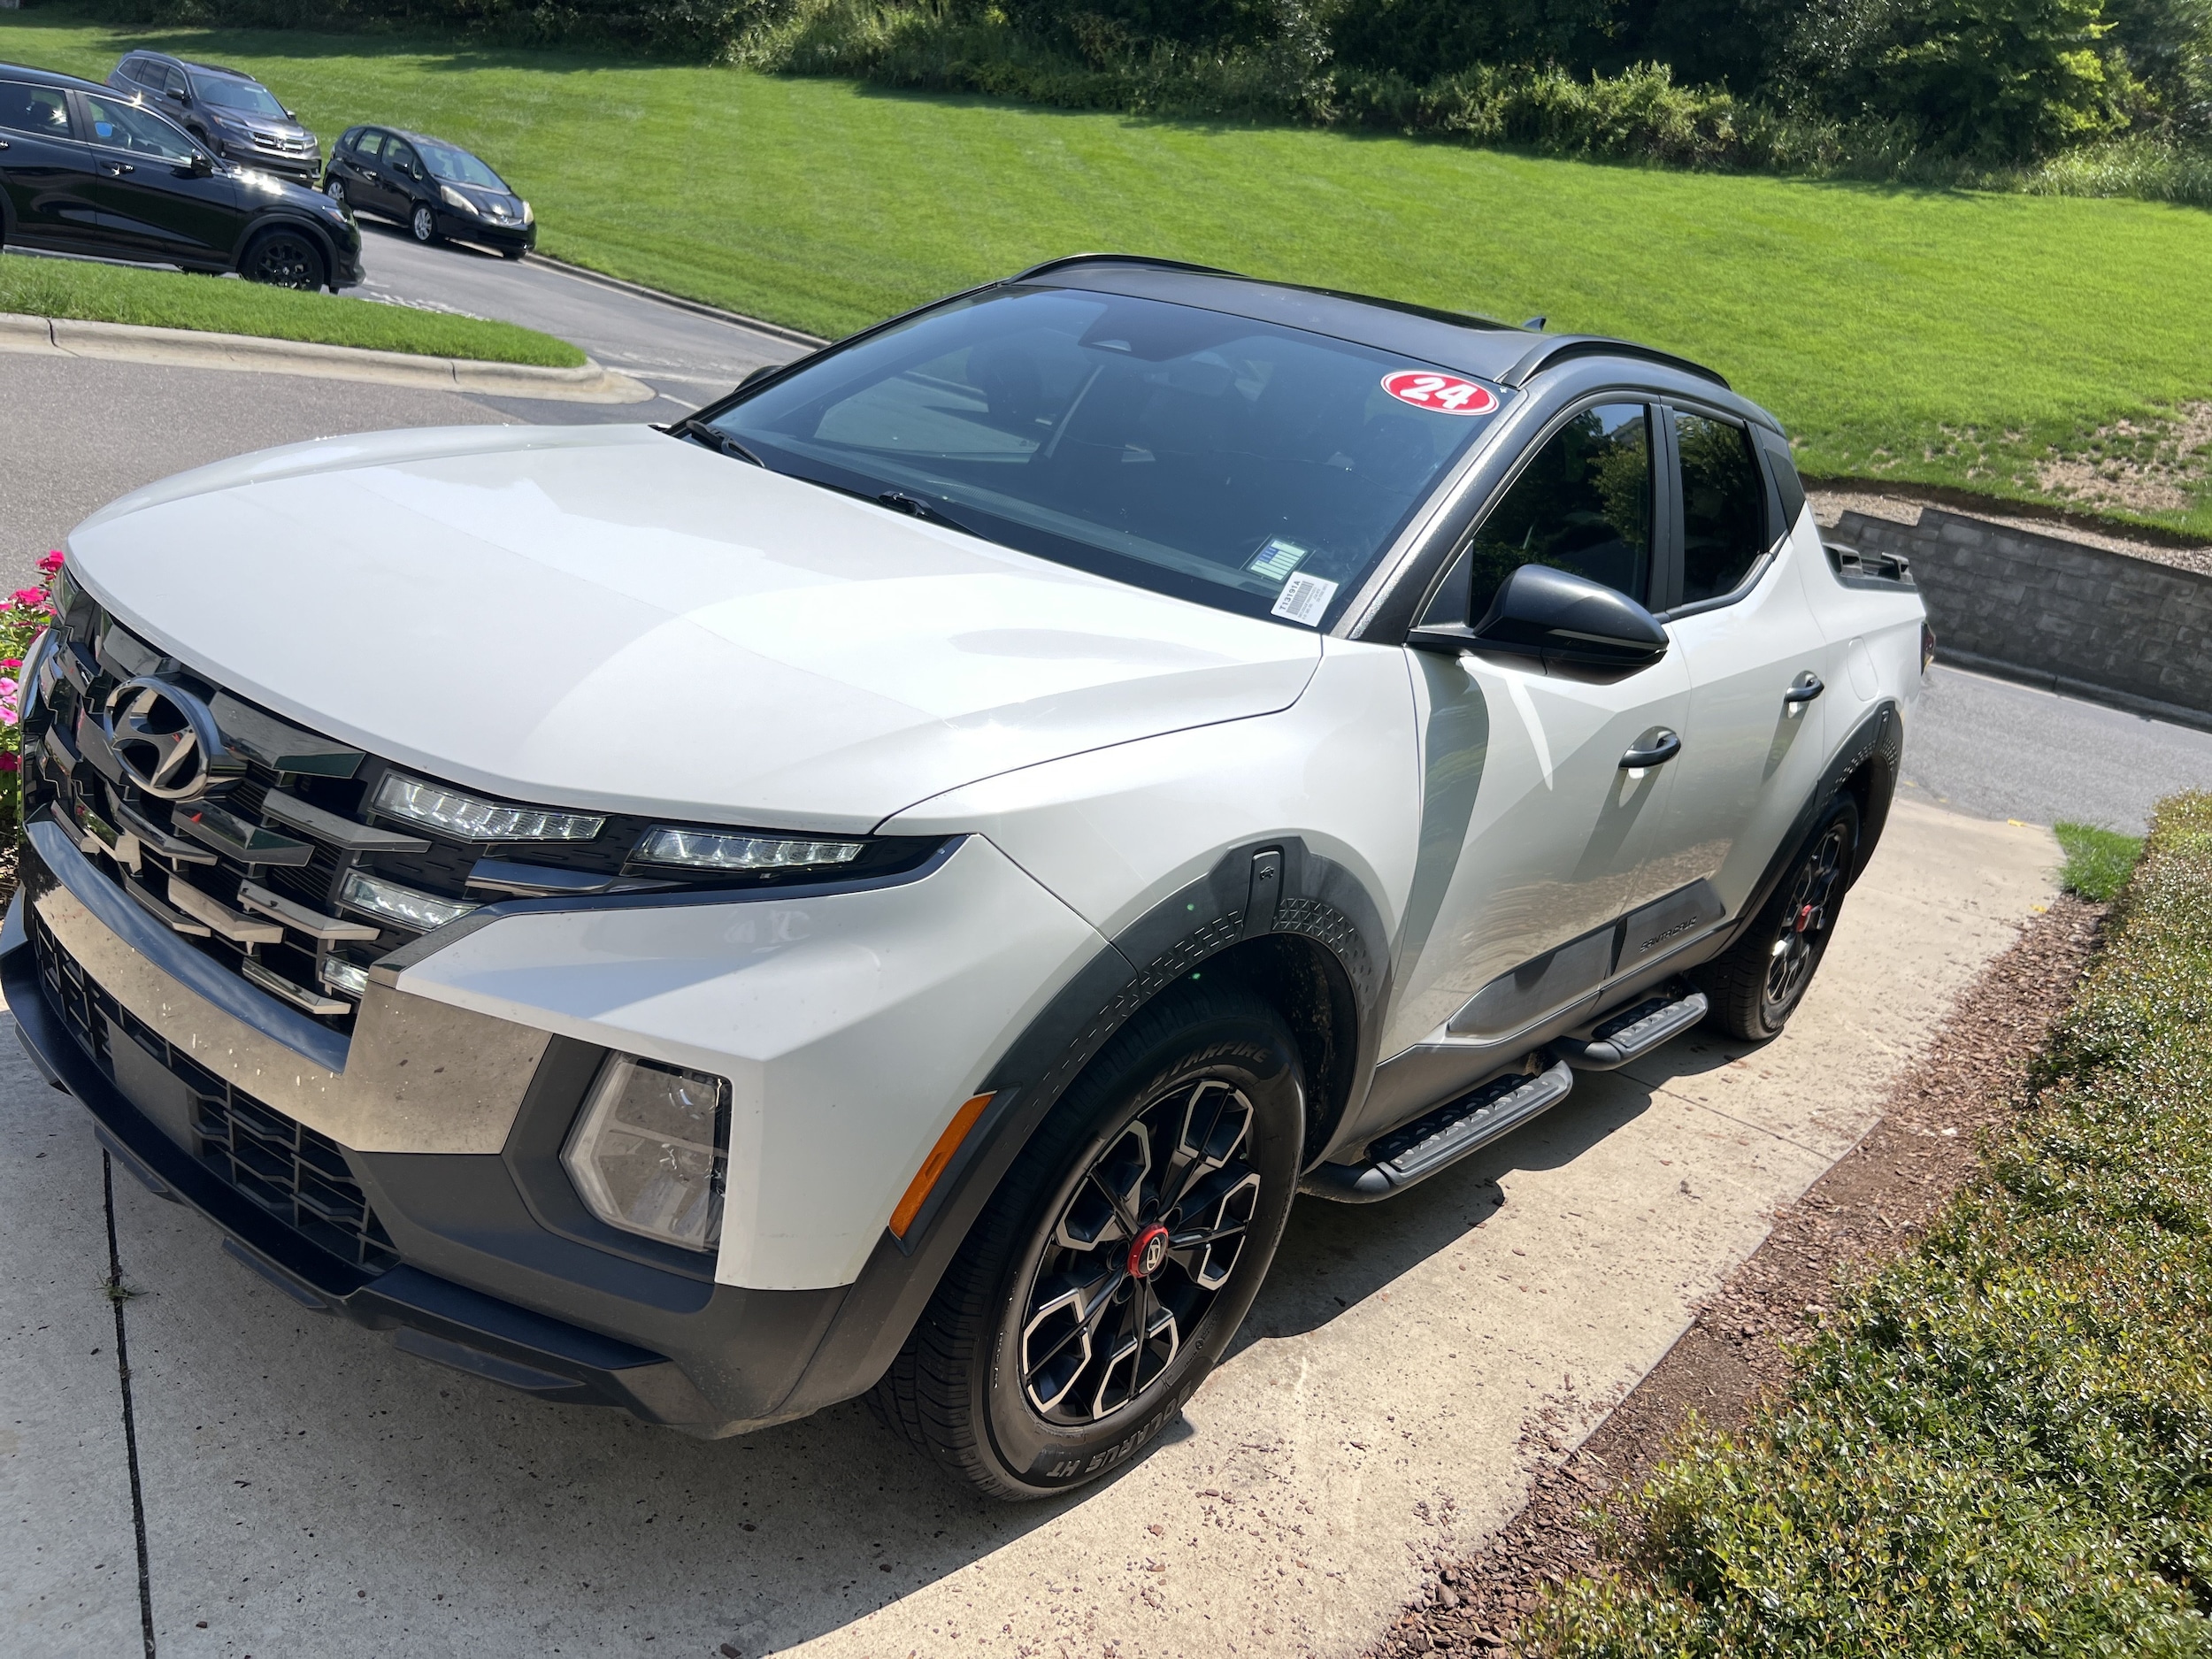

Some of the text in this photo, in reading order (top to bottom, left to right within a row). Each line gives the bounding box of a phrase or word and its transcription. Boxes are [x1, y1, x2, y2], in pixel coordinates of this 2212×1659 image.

[1399, 377, 1479, 410] 24
[1279, 580, 1301, 611] T13191A
[1046, 1459, 1081, 1478] HT
